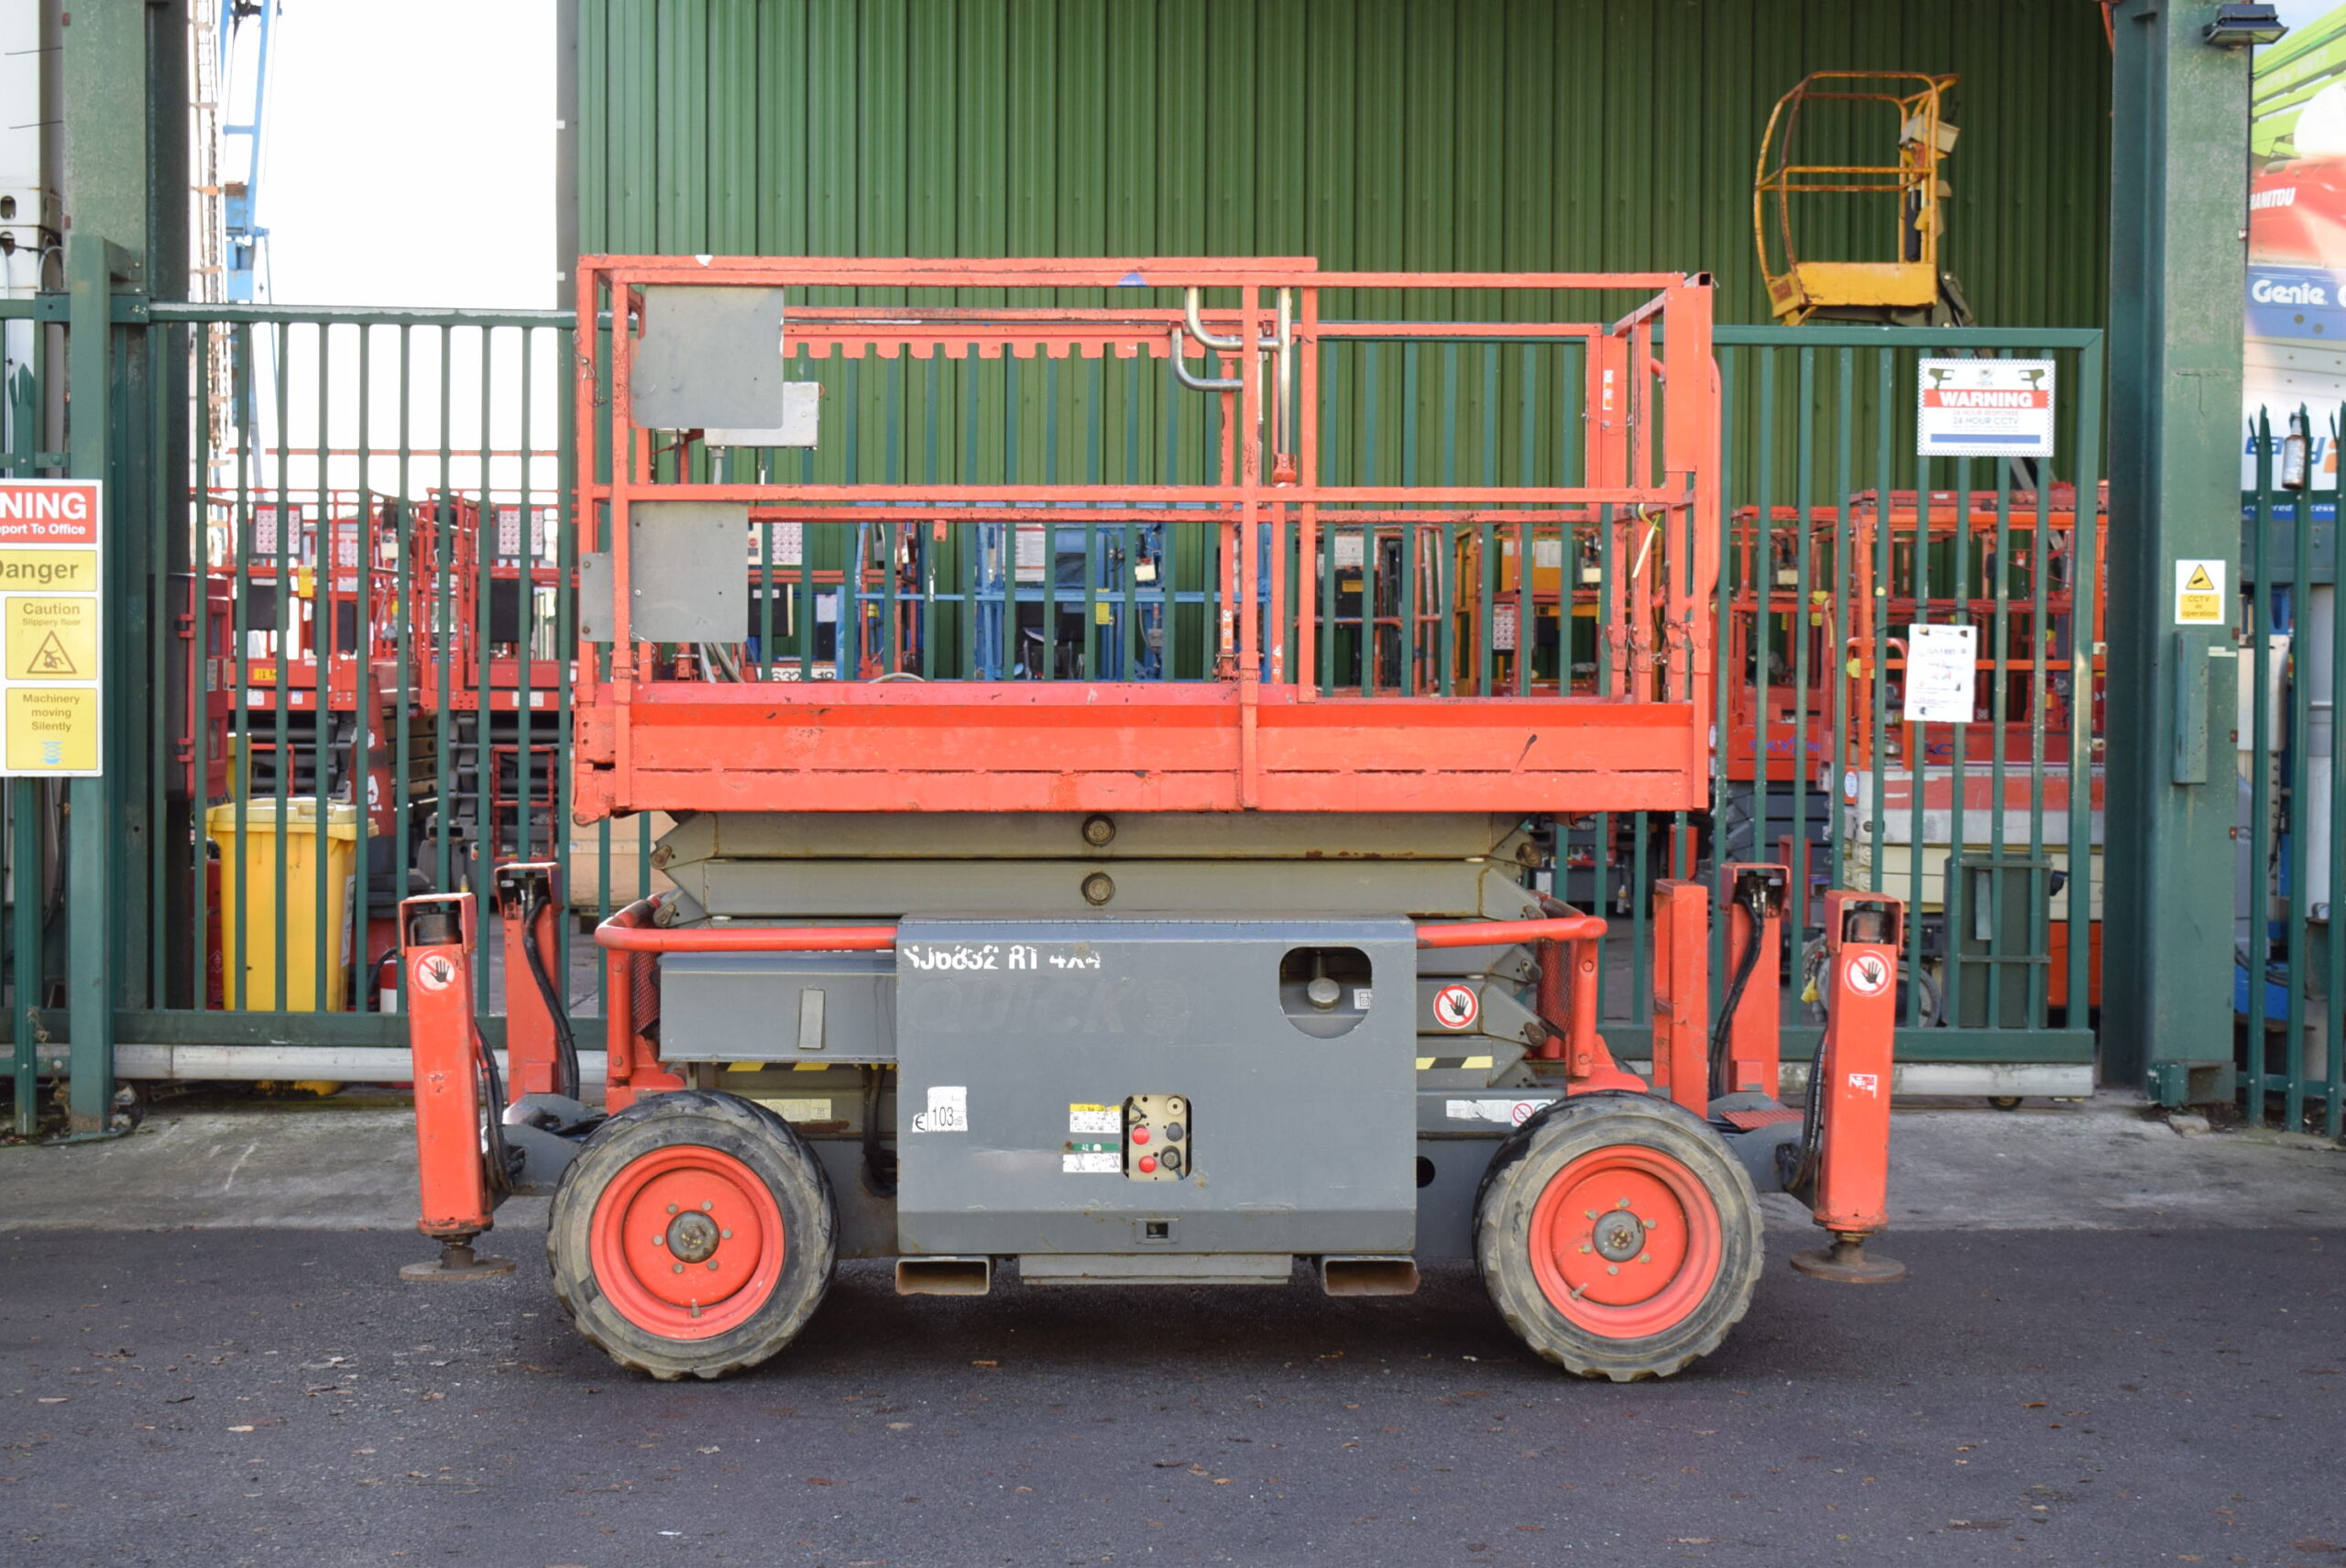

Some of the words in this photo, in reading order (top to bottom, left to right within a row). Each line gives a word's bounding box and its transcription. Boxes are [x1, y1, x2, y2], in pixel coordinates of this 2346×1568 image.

[2252, 280, 2327, 305] Genie
[1939, 391, 2033, 407] WARNING
[0, 523, 27, 535] port
[30, 523, 45, 534] To
[49, 523, 86, 534] Office
[0, 559, 79, 585] anger
[23, 602, 80, 615] Caution
[23, 694, 80, 706] Machinery
[32, 708, 71, 719] moving
[32, 721, 71, 732] Silently
[1009, 945, 1037, 970] RT
[932, 1106, 954, 1126] 103
